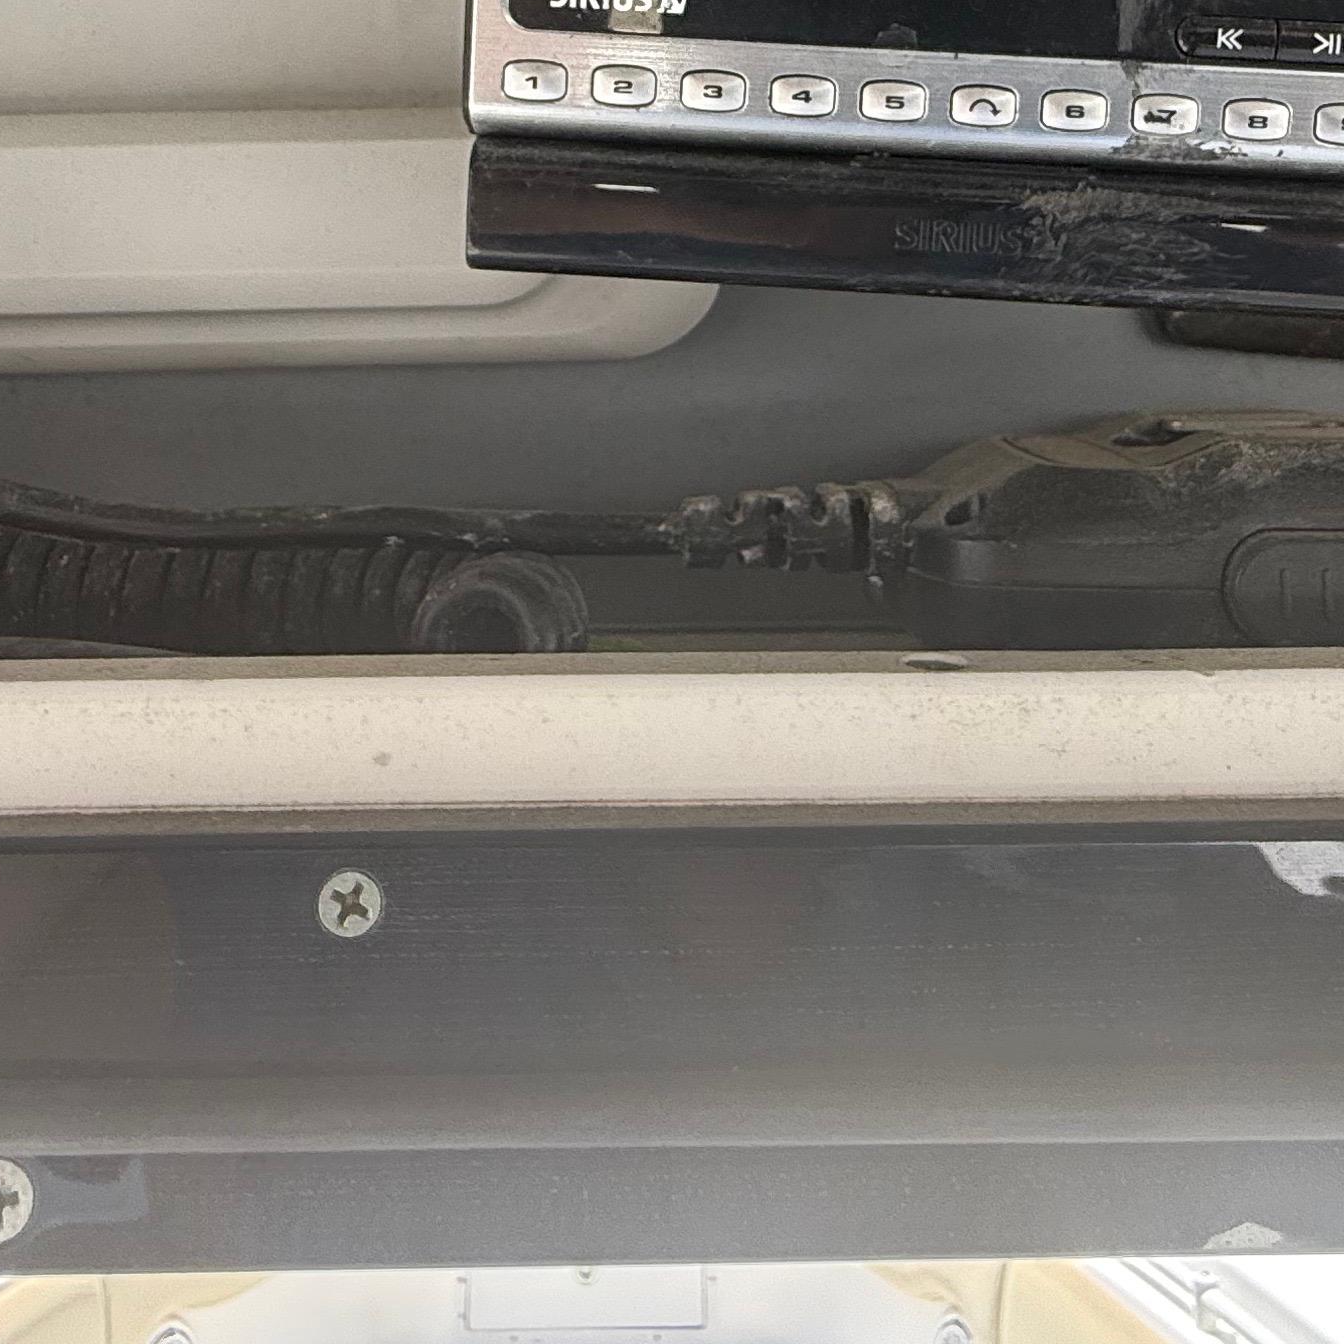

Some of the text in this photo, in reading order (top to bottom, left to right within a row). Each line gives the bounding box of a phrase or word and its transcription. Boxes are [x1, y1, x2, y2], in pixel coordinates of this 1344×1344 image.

[524, 75, 538, 90] 1
[613, 80, 633, 94] 2
[703, 84, 722, 99] 3
[791, 89, 812, 104] 4
[885, 95, 904, 109] 5
[1065, 105, 1084, 119] 6
[1248, 115, 1268, 129] 8
[893, 218, 1022, 257] SIRIUS
